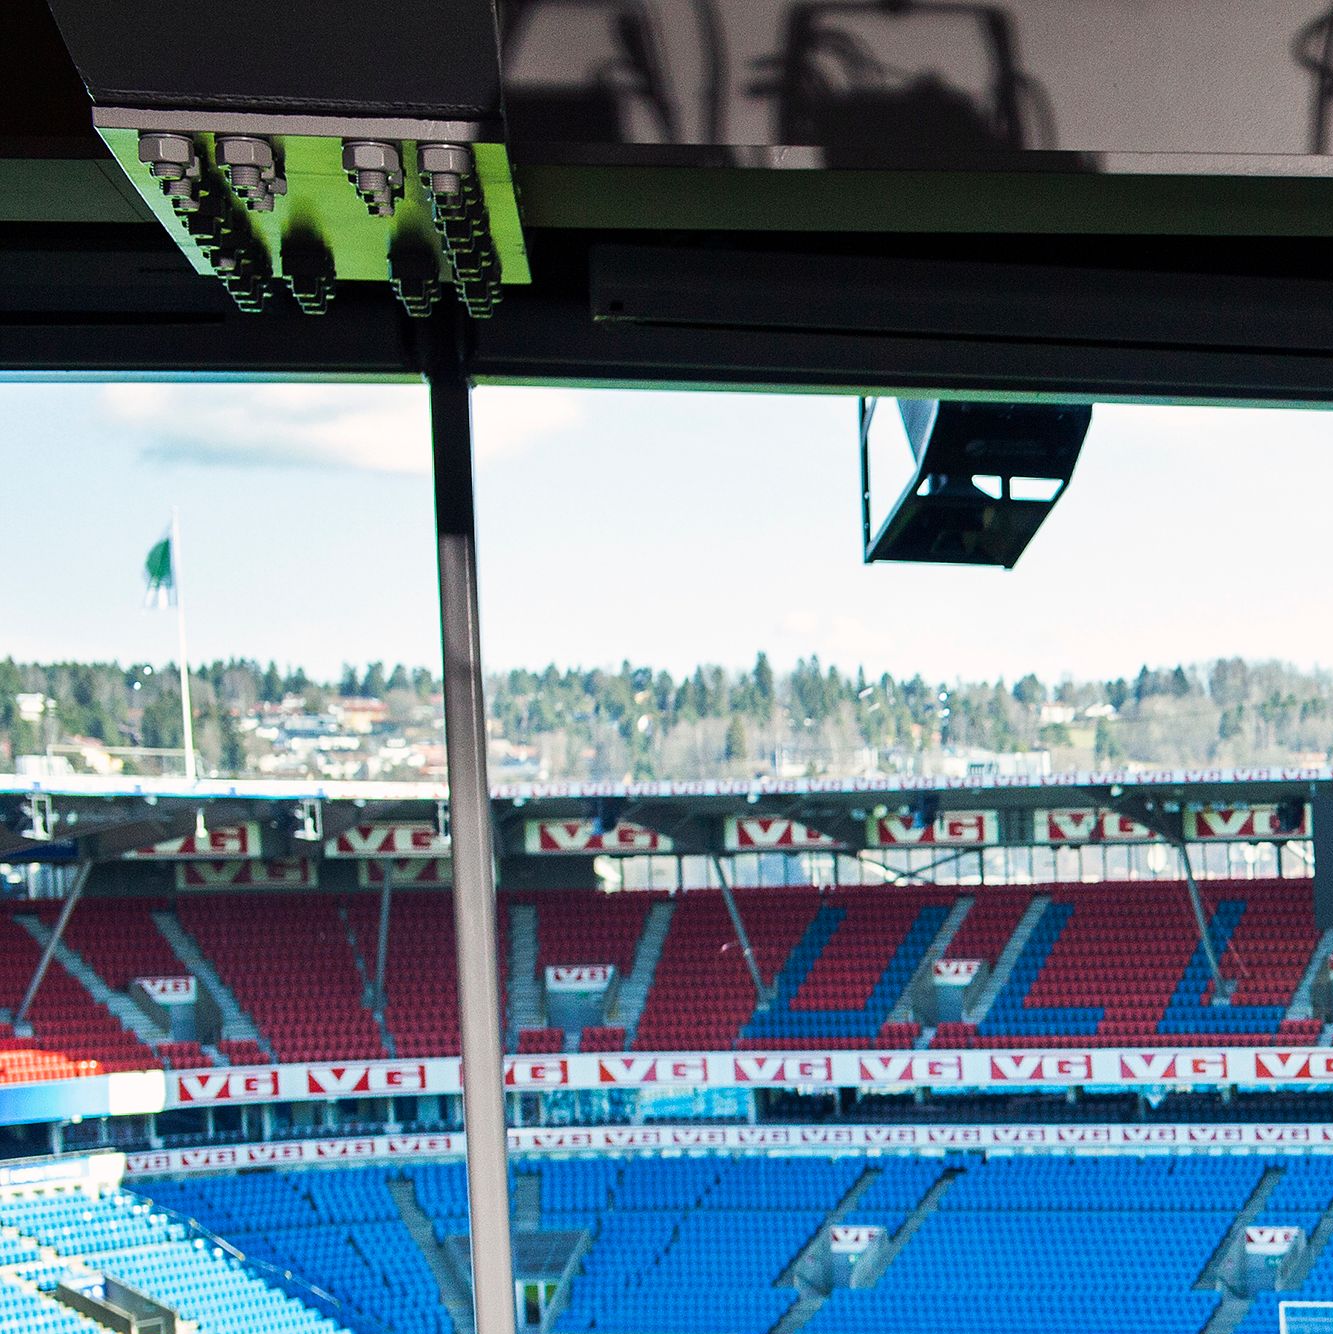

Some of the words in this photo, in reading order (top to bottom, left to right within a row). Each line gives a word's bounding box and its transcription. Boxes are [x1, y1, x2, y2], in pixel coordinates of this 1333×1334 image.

[554, 966, 609, 981] VG
[933, 960, 980, 977] VG
[179, 1071, 279, 1102] VG
[307, 1066, 426, 1094] VG
[599, 1059, 708, 1084] VG
[734, 1057, 832, 1083] VG
[859, 1056, 962, 1081] VG
[991, 1055, 1092, 1081] VG
[1120, 1054, 1227, 1080] VG
[534, 1133, 592, 1149] VG
[605, 1132, 659, 1147] VG
[673, 1130, 726, 1146] VG
[739, 1129, 790, 1144] VG
[802, 1129, 852, 1143] VG
[864, 1128, 916, 1143] VG
[929, 1128, 980, 1142] VG
[993, 1128, 1045, 1142] VG
[1058, 1128, 1110, 1142] VG
[1122, 1127, 1176, 1142] VG
[1188, 1127, 1242, 1141] VG
[1255, 1127, 1309, 1141] VG
[127, 1154, 171, 1174] VG
[182, 1149, 236, 1169] VG
[248, 1145, 302, 1164] VG
[317, 1141, 375, 1159] VG
[389, 1138, 451, 1156] VG
